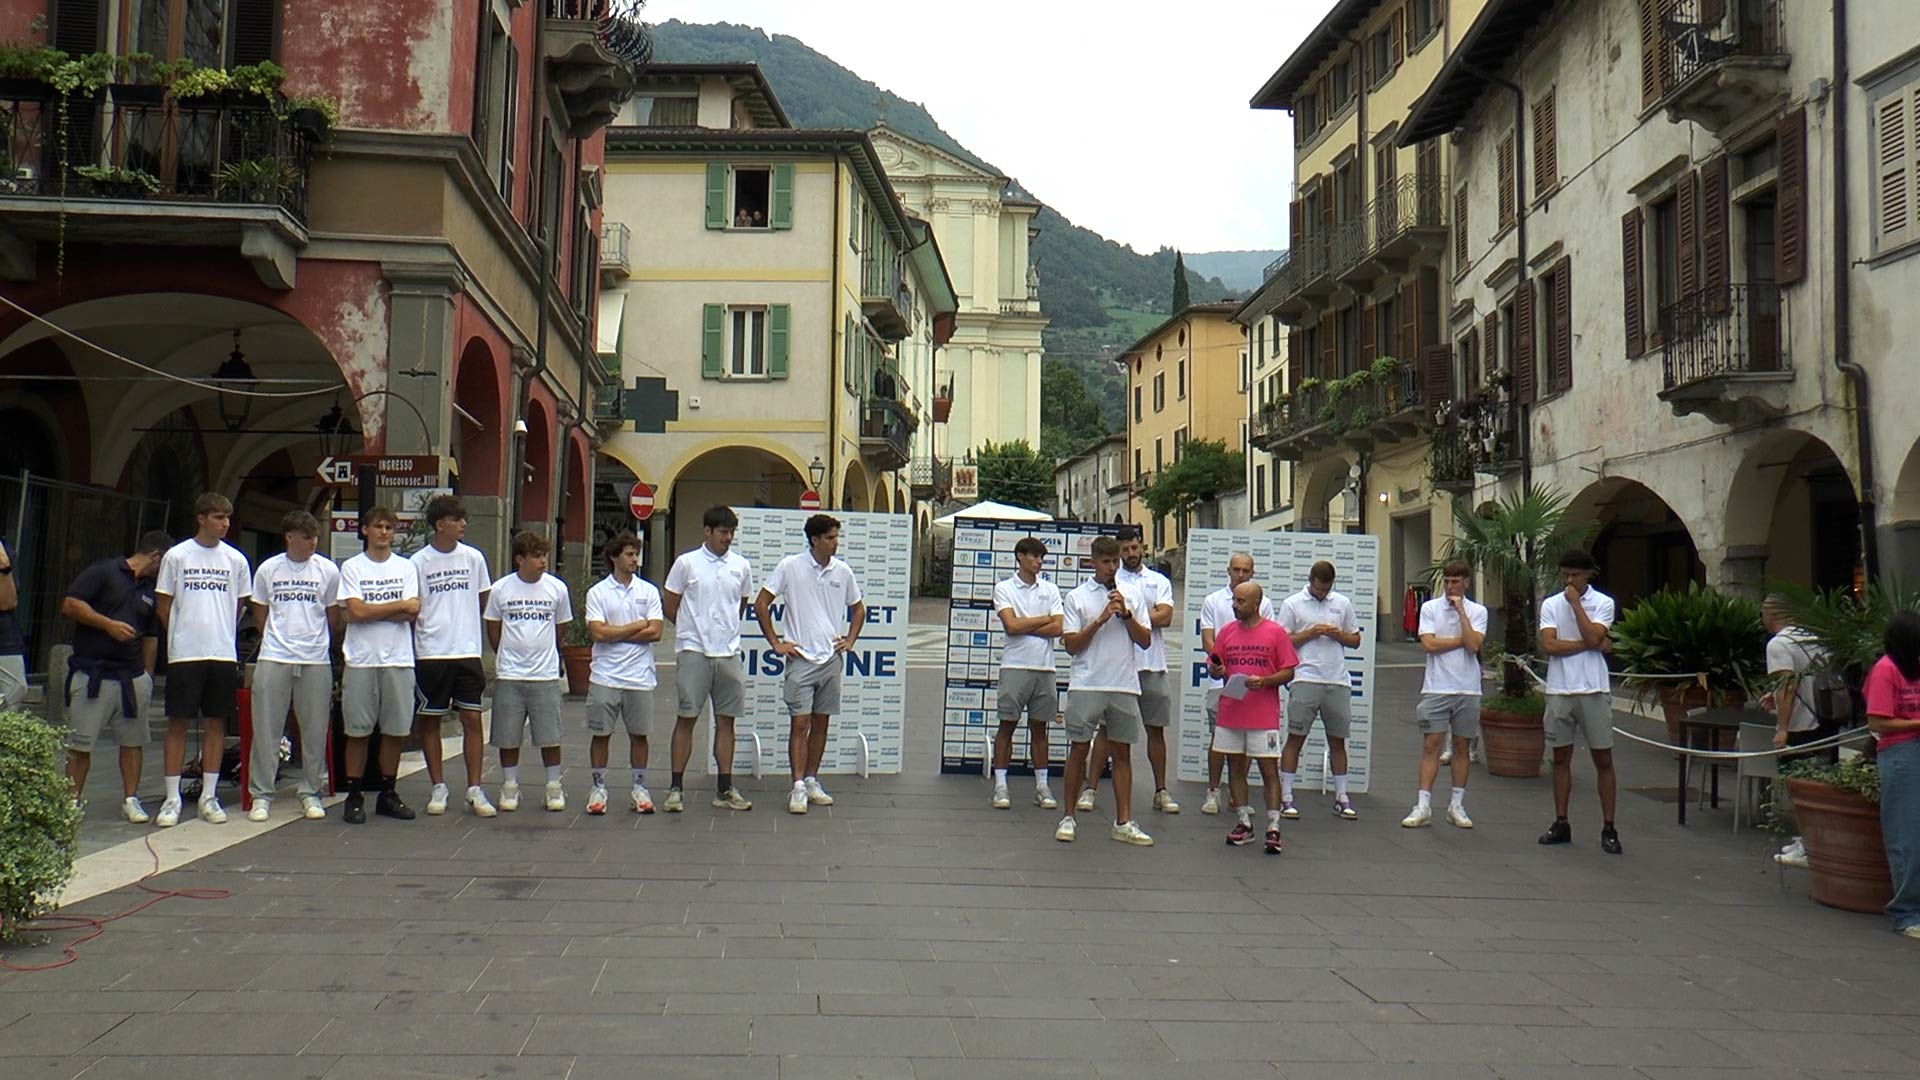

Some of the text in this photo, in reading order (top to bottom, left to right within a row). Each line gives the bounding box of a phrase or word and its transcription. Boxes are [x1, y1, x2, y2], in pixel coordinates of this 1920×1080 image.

[378, 459, 413, 471] INGRESSO
[202, 568, 230, 576] BASKET
[426, 569, 469, 580] NEW BASKET
[183, 581, 228, 592] PISOGNE
[291, 580, 320, 588] BASKET
[376, 578, 404, 586] BASKET
[428, 581, 470, 594] PISOGNE
[273, 592, 318, 603] PISOGNE
[524, 599, 552, 607] BASKET
[508, 611, 552, 621] PISOGNE
